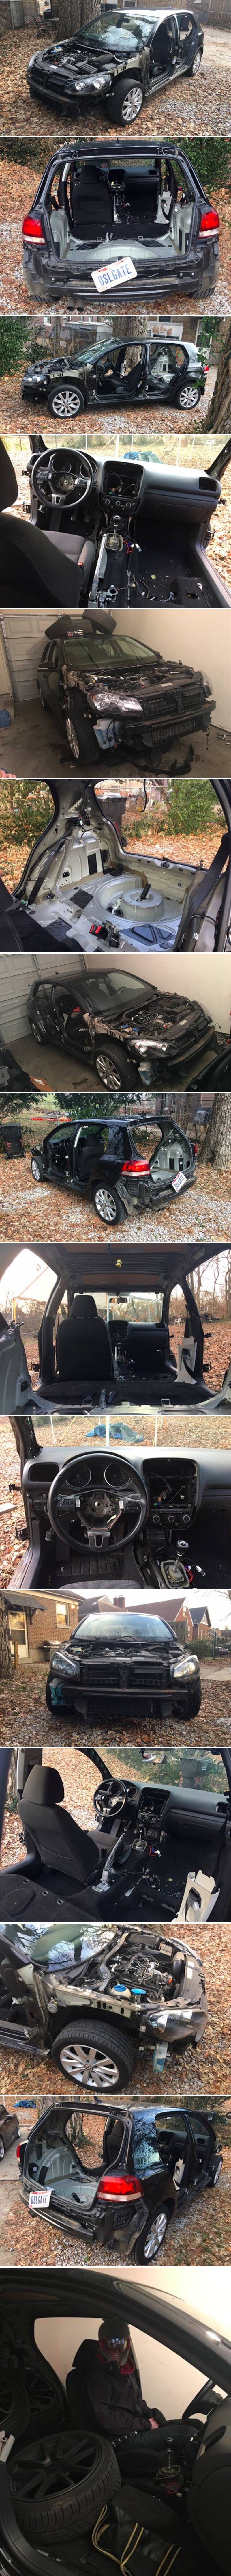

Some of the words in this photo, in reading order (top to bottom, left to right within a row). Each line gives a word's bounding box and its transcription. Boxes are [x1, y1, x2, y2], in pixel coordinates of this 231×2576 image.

[97, 264, 132, 286] DSLGATE
[174, 1175, 185, 1189] DSLGATE
[31, 2195, 48, 2204] DSLGATE
